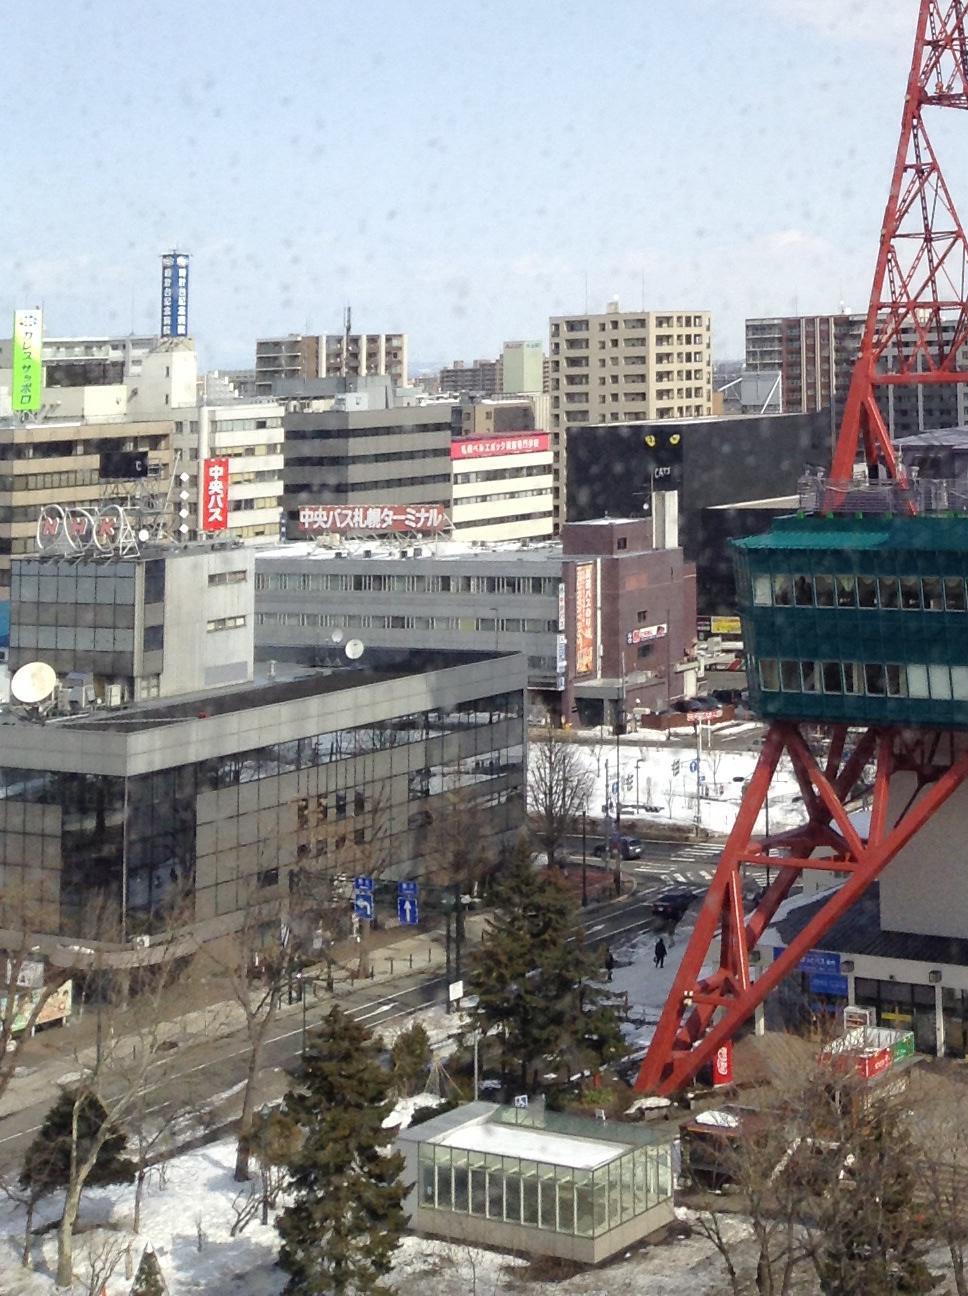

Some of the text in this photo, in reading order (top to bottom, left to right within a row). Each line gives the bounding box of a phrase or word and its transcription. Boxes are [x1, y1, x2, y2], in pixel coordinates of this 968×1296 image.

[208, 464, 224, 523] 中央バス
[42, 515, 118, 536] NHK
[299, 507, 443, 529] 中央バス札幌ターミナル
